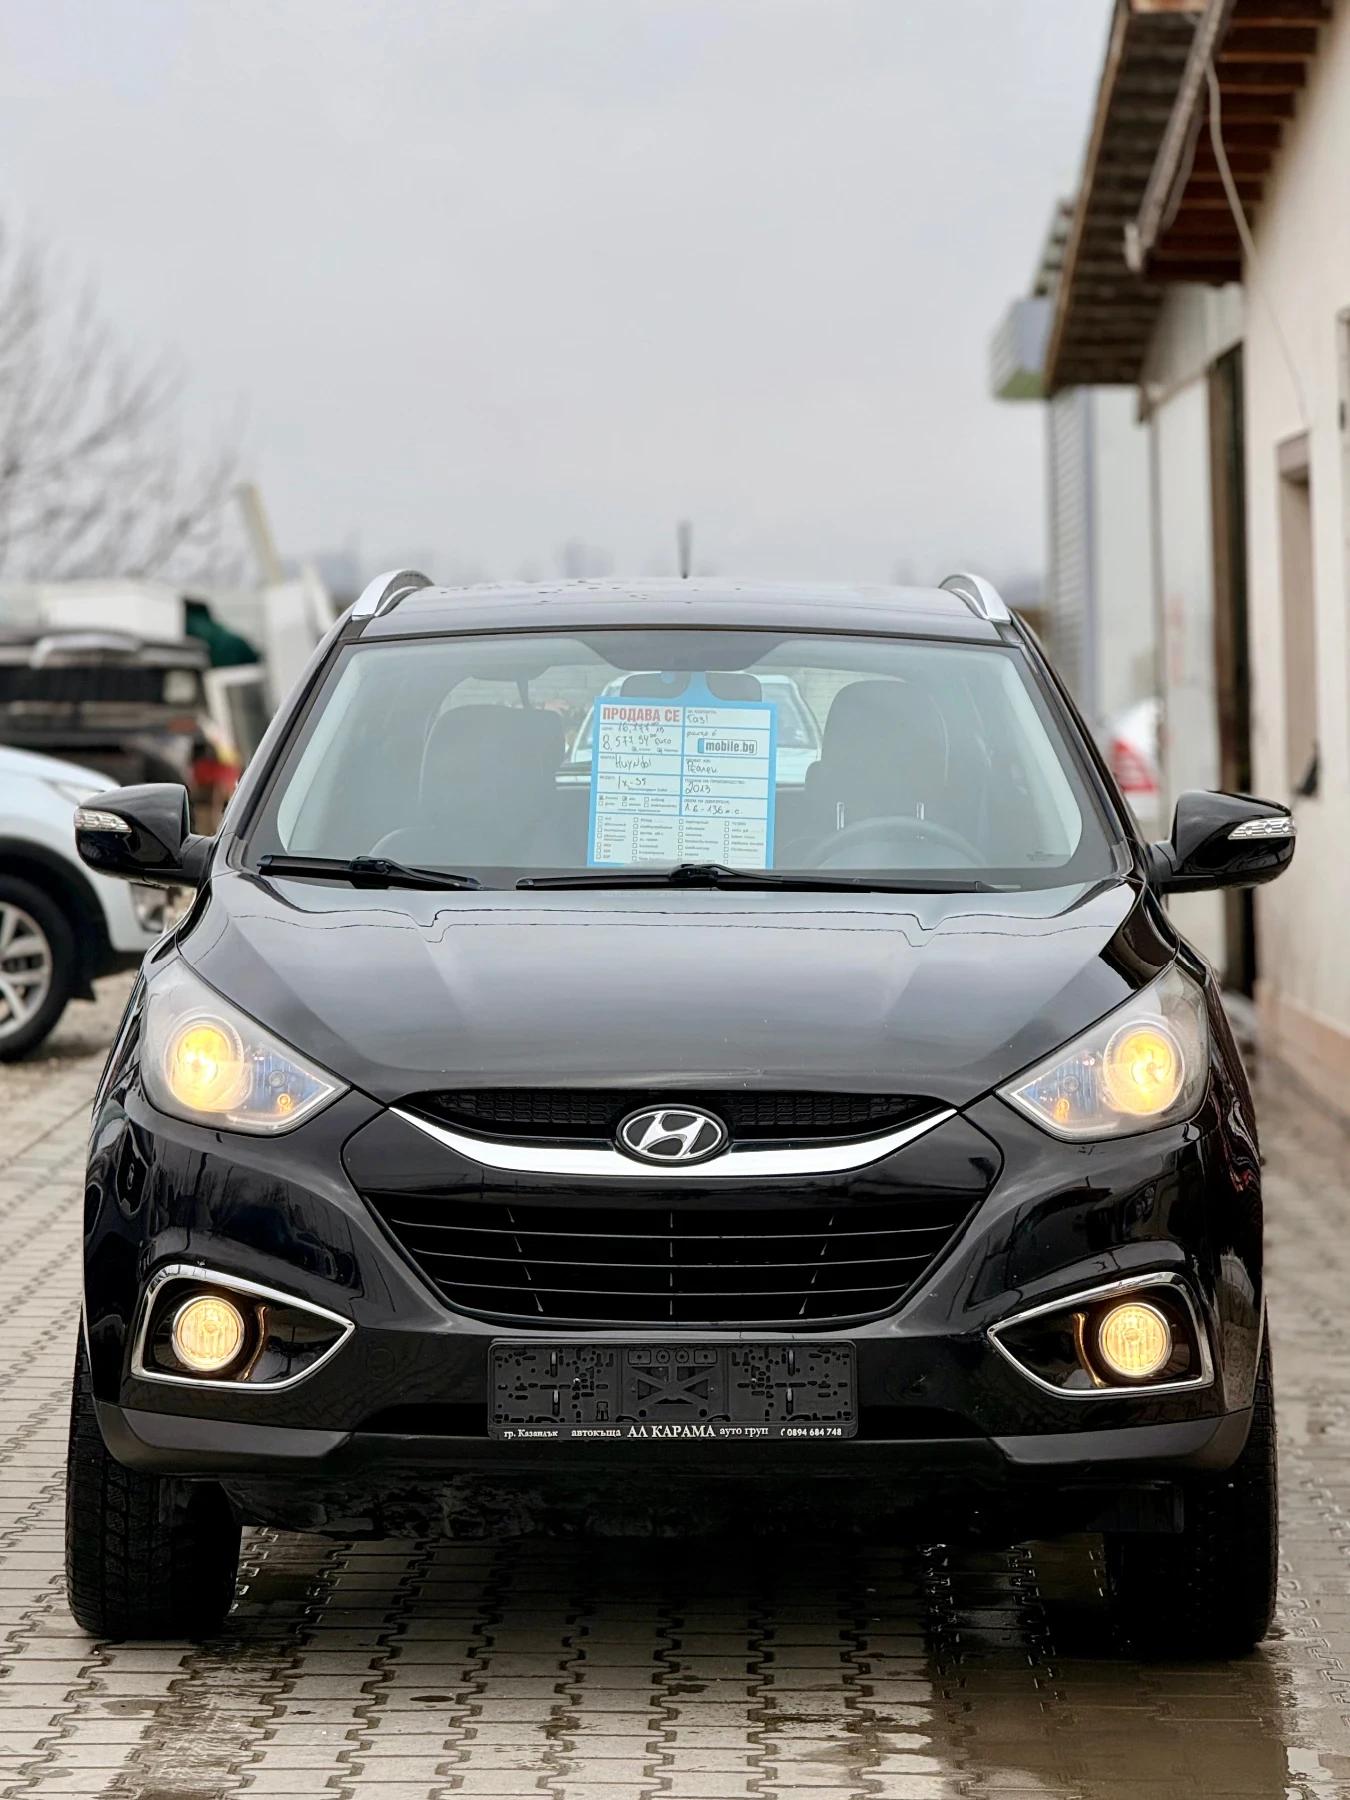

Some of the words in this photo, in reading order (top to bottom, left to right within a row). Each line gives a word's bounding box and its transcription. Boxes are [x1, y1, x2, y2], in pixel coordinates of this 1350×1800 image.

[602, 707, 660, 722] ПРОДАВА
[664, 709, 680, 722] СЕ
[705, 741, 755, 754] mobile.bg
[685, 782, 711, 794] 2013
[503, 1430, 516, 1439] гр.
[518, 1429, 559, 1437] Казанлък
[571, 1429, 622, 1439] автокъща
[627, 1425, 649, 1438] АЛ
[651, 1425, 716, 1438] КАРАМА
[719, 1429, 743, 1438] ауто
[744, 1428, 769, 1438] груп
[787, 1428, 808, 1437] 0894
[809, 1428, 825, 1437] 684
[826, 1428, 842, 1437] 748
